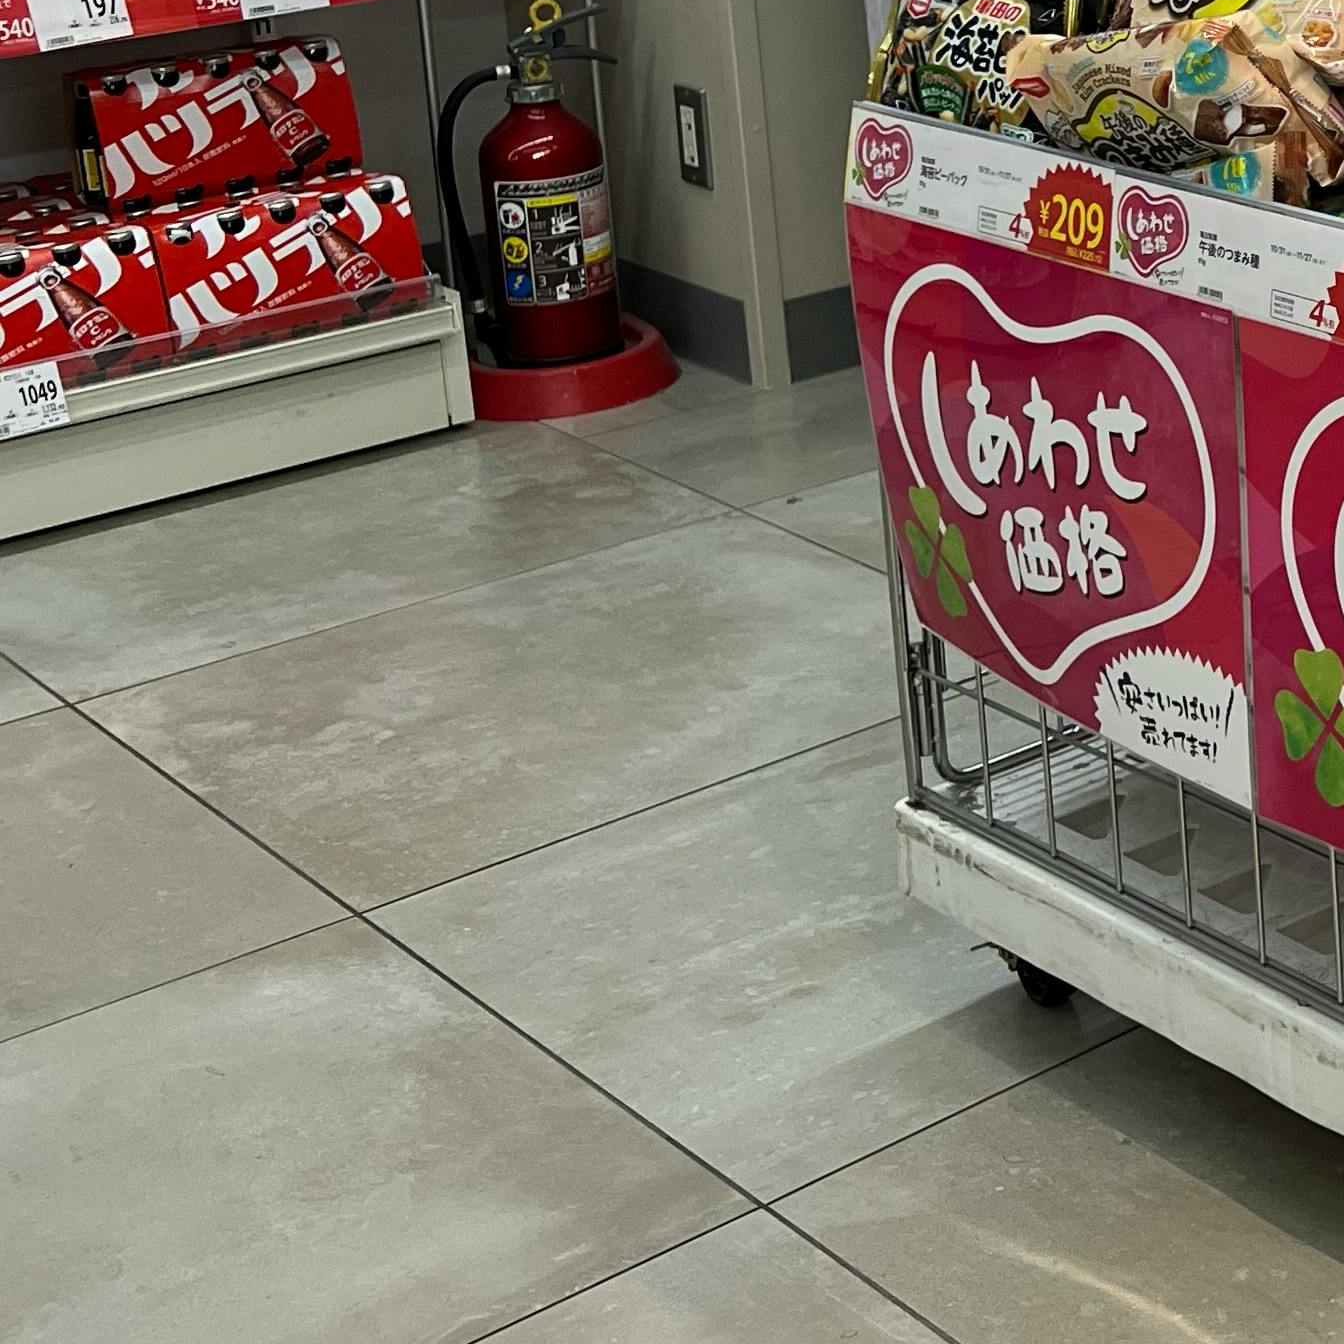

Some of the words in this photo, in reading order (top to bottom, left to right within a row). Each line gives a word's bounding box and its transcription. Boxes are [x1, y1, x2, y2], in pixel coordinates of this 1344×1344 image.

[1040, 193, 1105, 249] ¥209
[18, 380, 58, 406] 1049
[921, 350, 1148, 516] しあわせ
[1000, 503, 1127, 597] 価格
